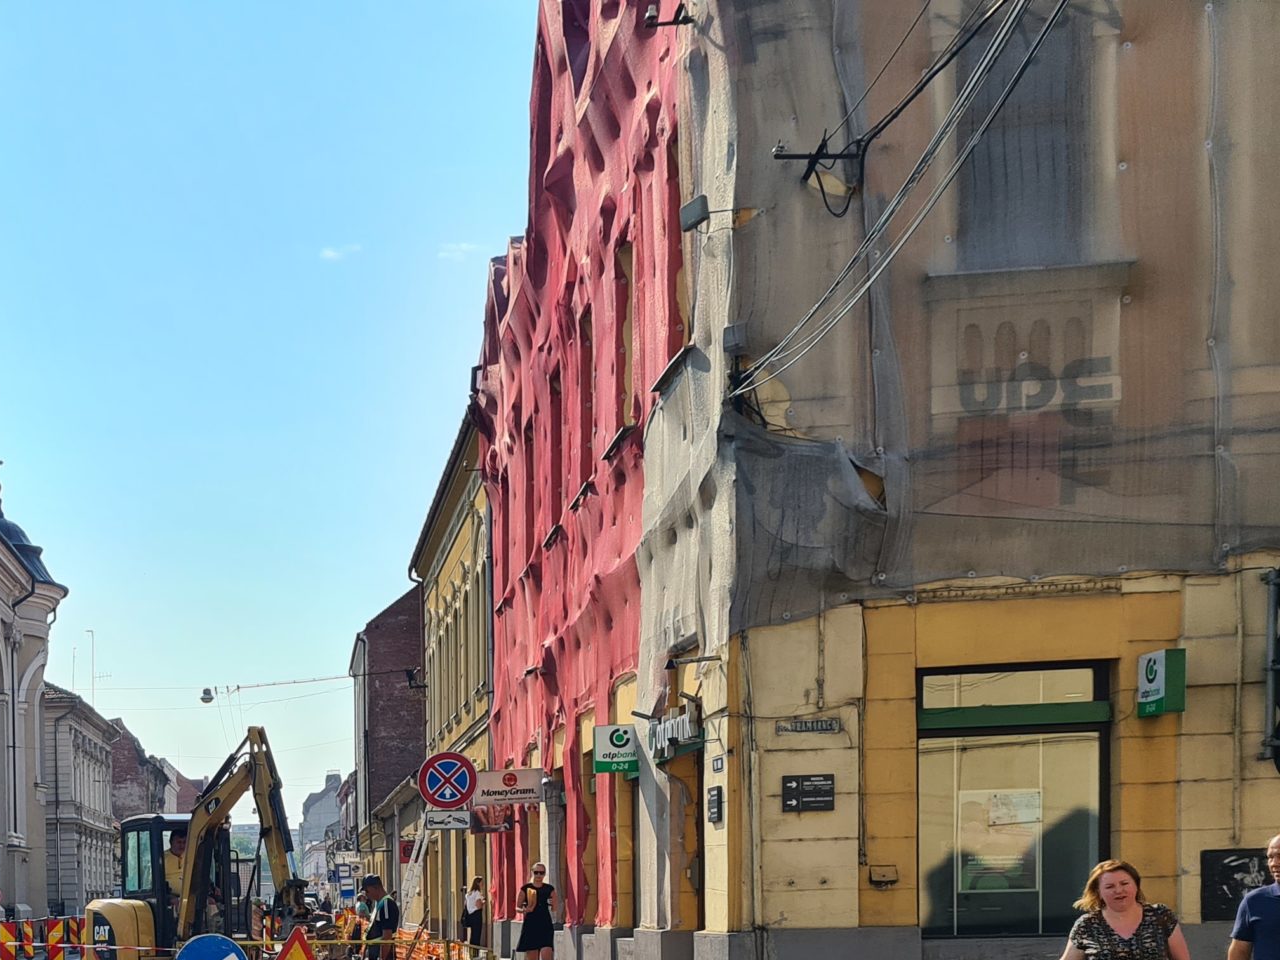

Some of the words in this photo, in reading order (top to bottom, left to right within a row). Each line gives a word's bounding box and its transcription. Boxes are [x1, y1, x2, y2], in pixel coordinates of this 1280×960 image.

[602, 751, 637, 761] otpbank
[611, 761, 629, 770] 0-24
[94, 925, 110, 941] CAT
